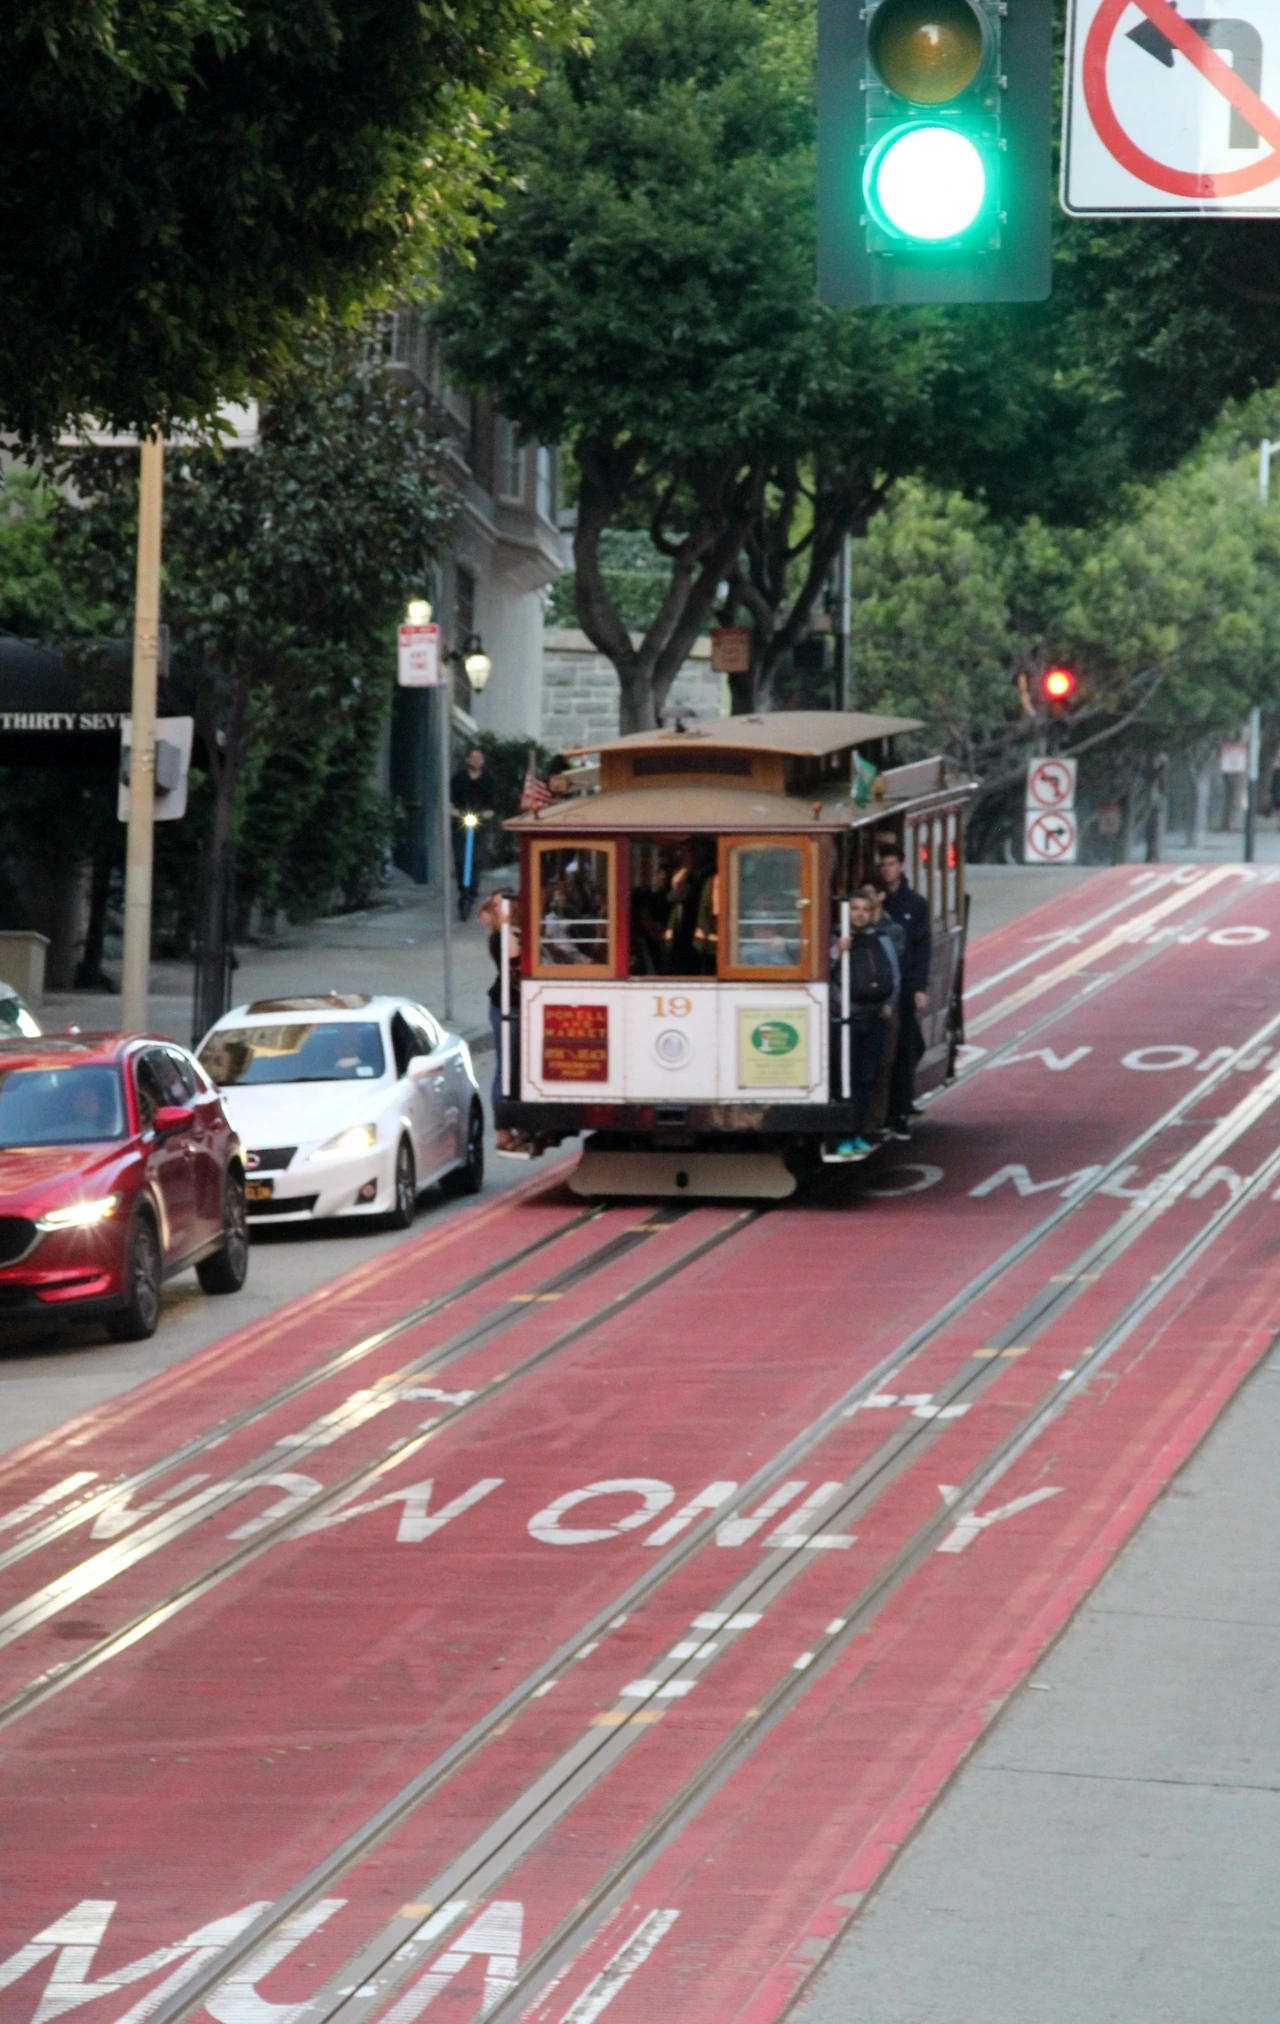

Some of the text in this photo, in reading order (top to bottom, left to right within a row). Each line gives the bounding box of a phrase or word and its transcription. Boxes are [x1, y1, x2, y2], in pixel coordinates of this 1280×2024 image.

[1, 712, 76, 730] THIRTY
[651, 995, 693, 1018] 19
[968, 1163, 1280, 1208] MUN
[527, 1477, 1066, 1553] ONLY
